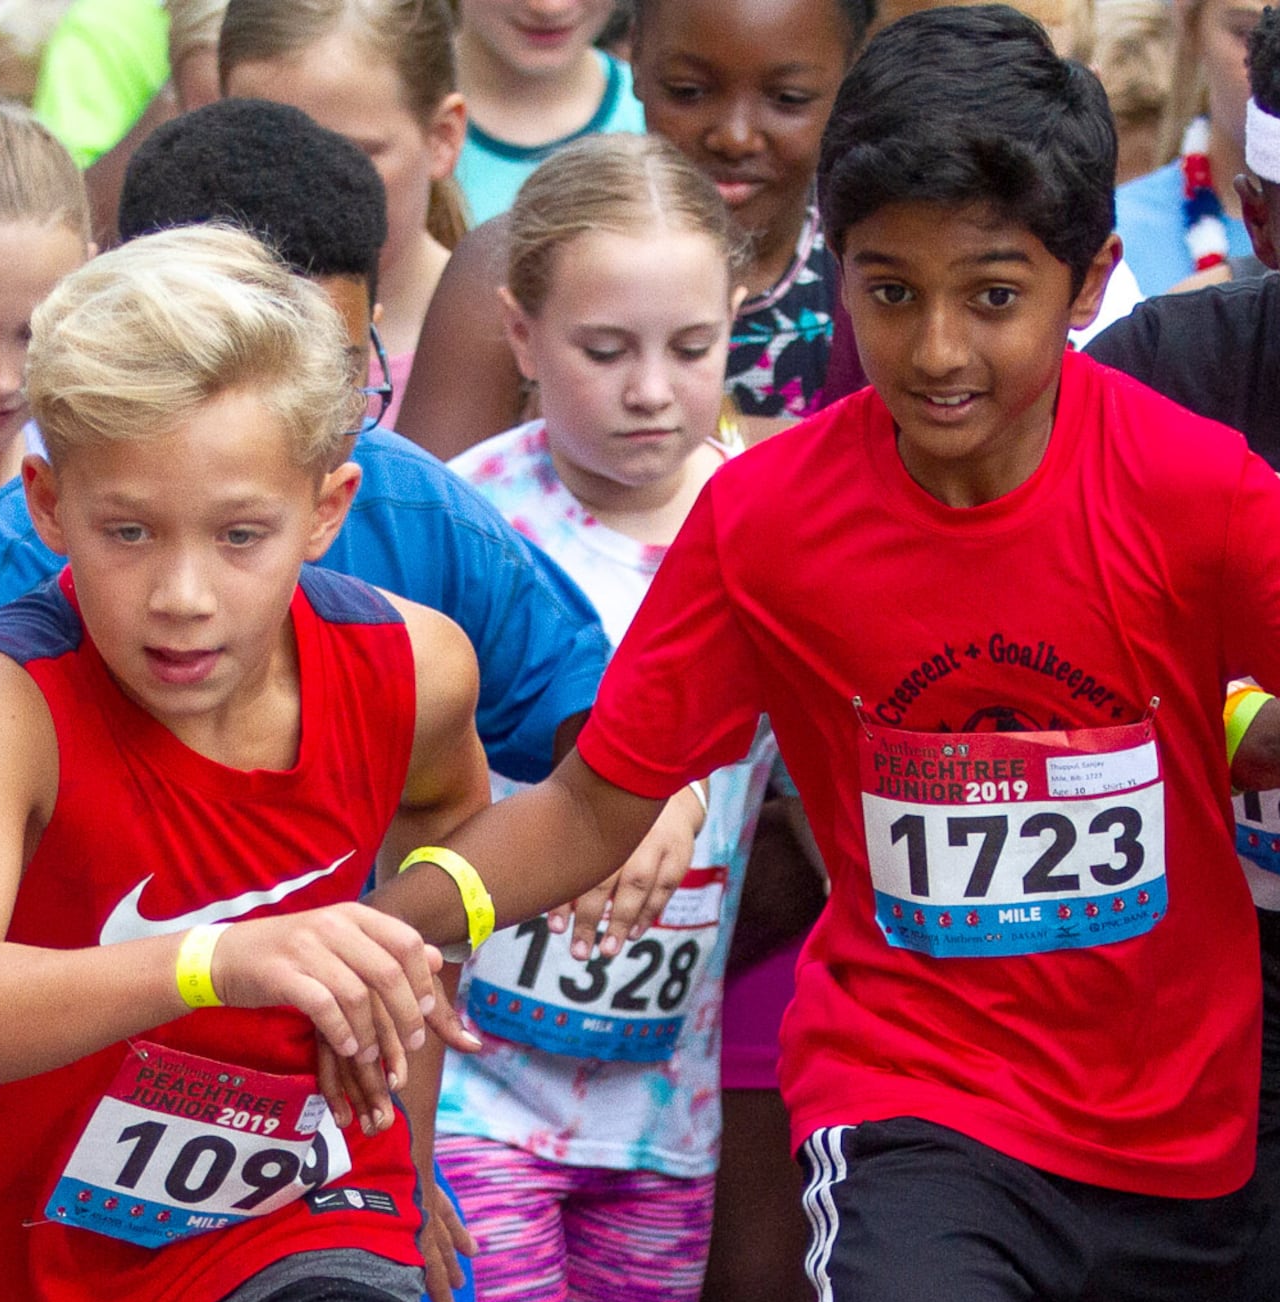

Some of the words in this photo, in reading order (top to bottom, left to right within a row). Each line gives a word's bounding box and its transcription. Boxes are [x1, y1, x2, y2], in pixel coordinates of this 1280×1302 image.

[875, 642, 961, 726] Crescent
[989, 633, 1116, 709] Goalkeeper
[874, 753, 1025, 780] PEACHTREE
[875, 776, 963, 802] JUNIOR
[965, 780, 1029, 803] 2019
[890, 806, 1145, 899] 1723
[998, 907, 1041, 924] MILE
[514, 915, 700, 1012] 1328
[154, 1056, 213, 1081] Anthem
[132, 1087, 221, 1122] JUNIOR
[216, 1107, 280, 1135] 2019
[135, 1067, 287, 1118] PEACHTREE
[186, 1214, 229, 1229] MILE
